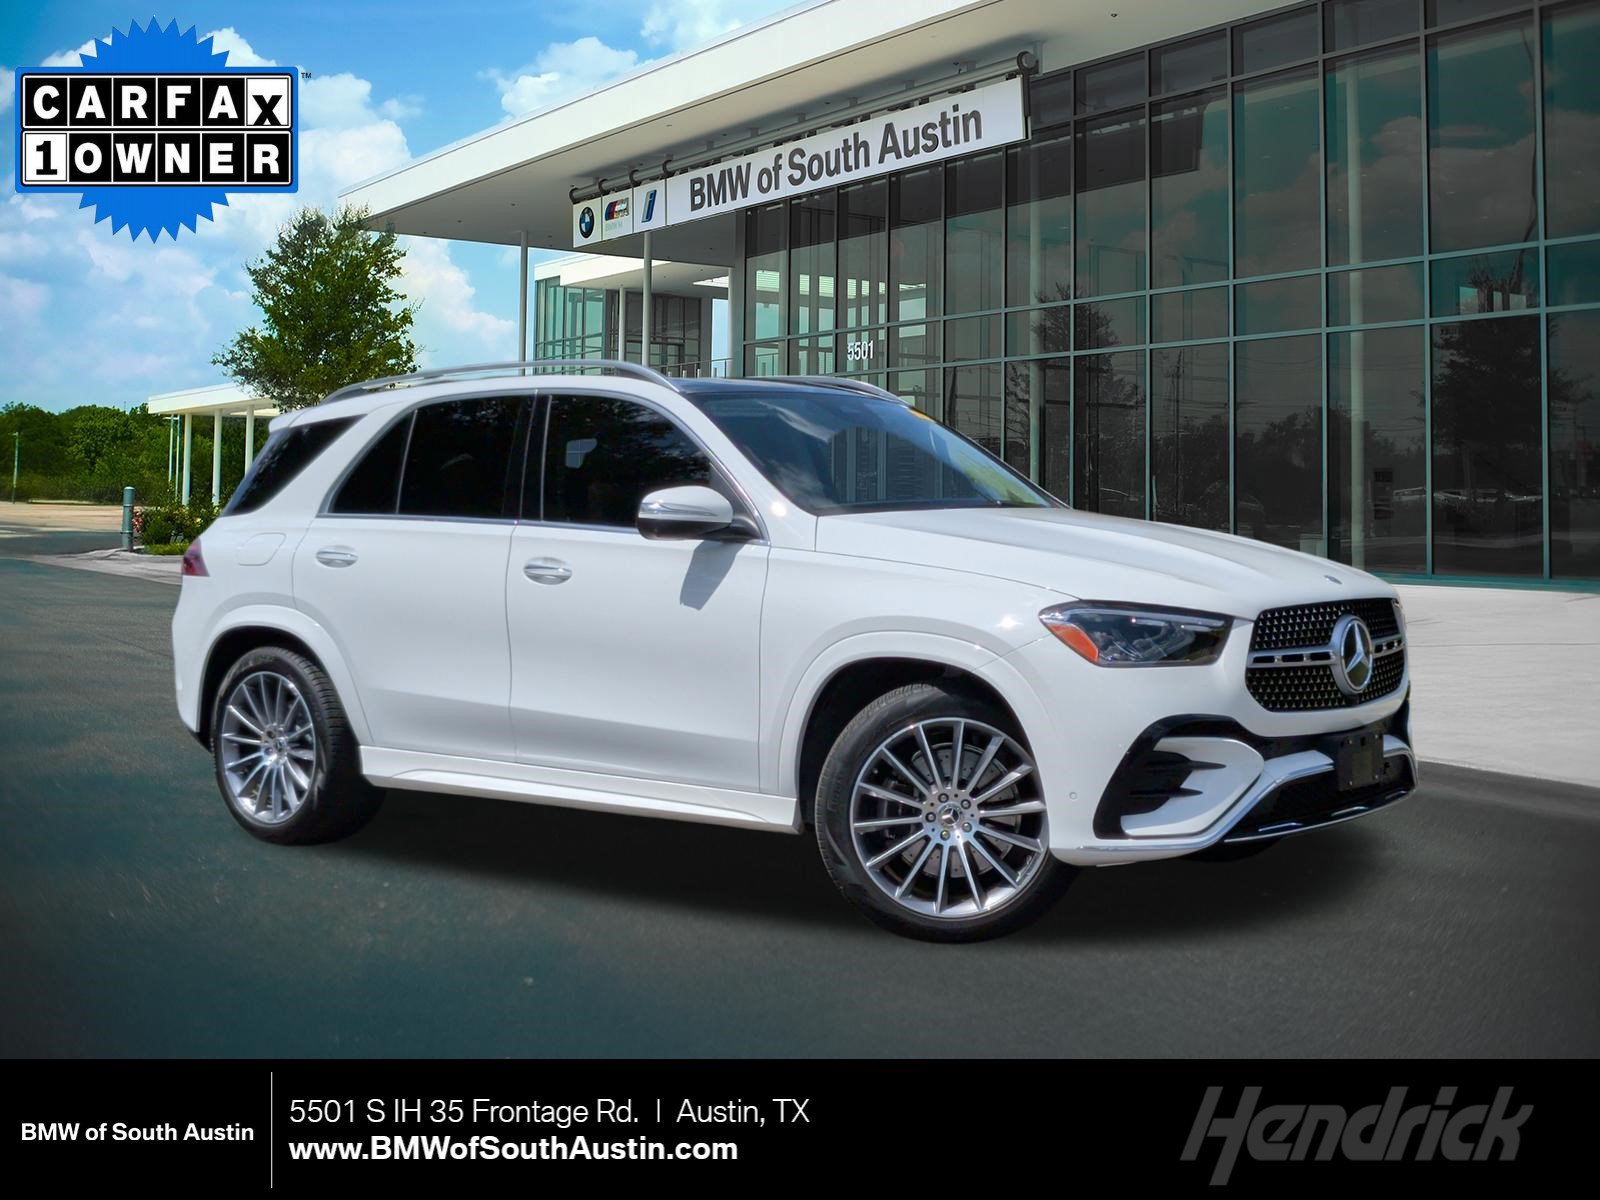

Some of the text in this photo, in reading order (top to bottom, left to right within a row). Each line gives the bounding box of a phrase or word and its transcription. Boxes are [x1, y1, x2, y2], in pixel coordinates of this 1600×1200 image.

[690, 104, 983, 212] BMW of South Austin
[847, 340, 874, 360] 5501
